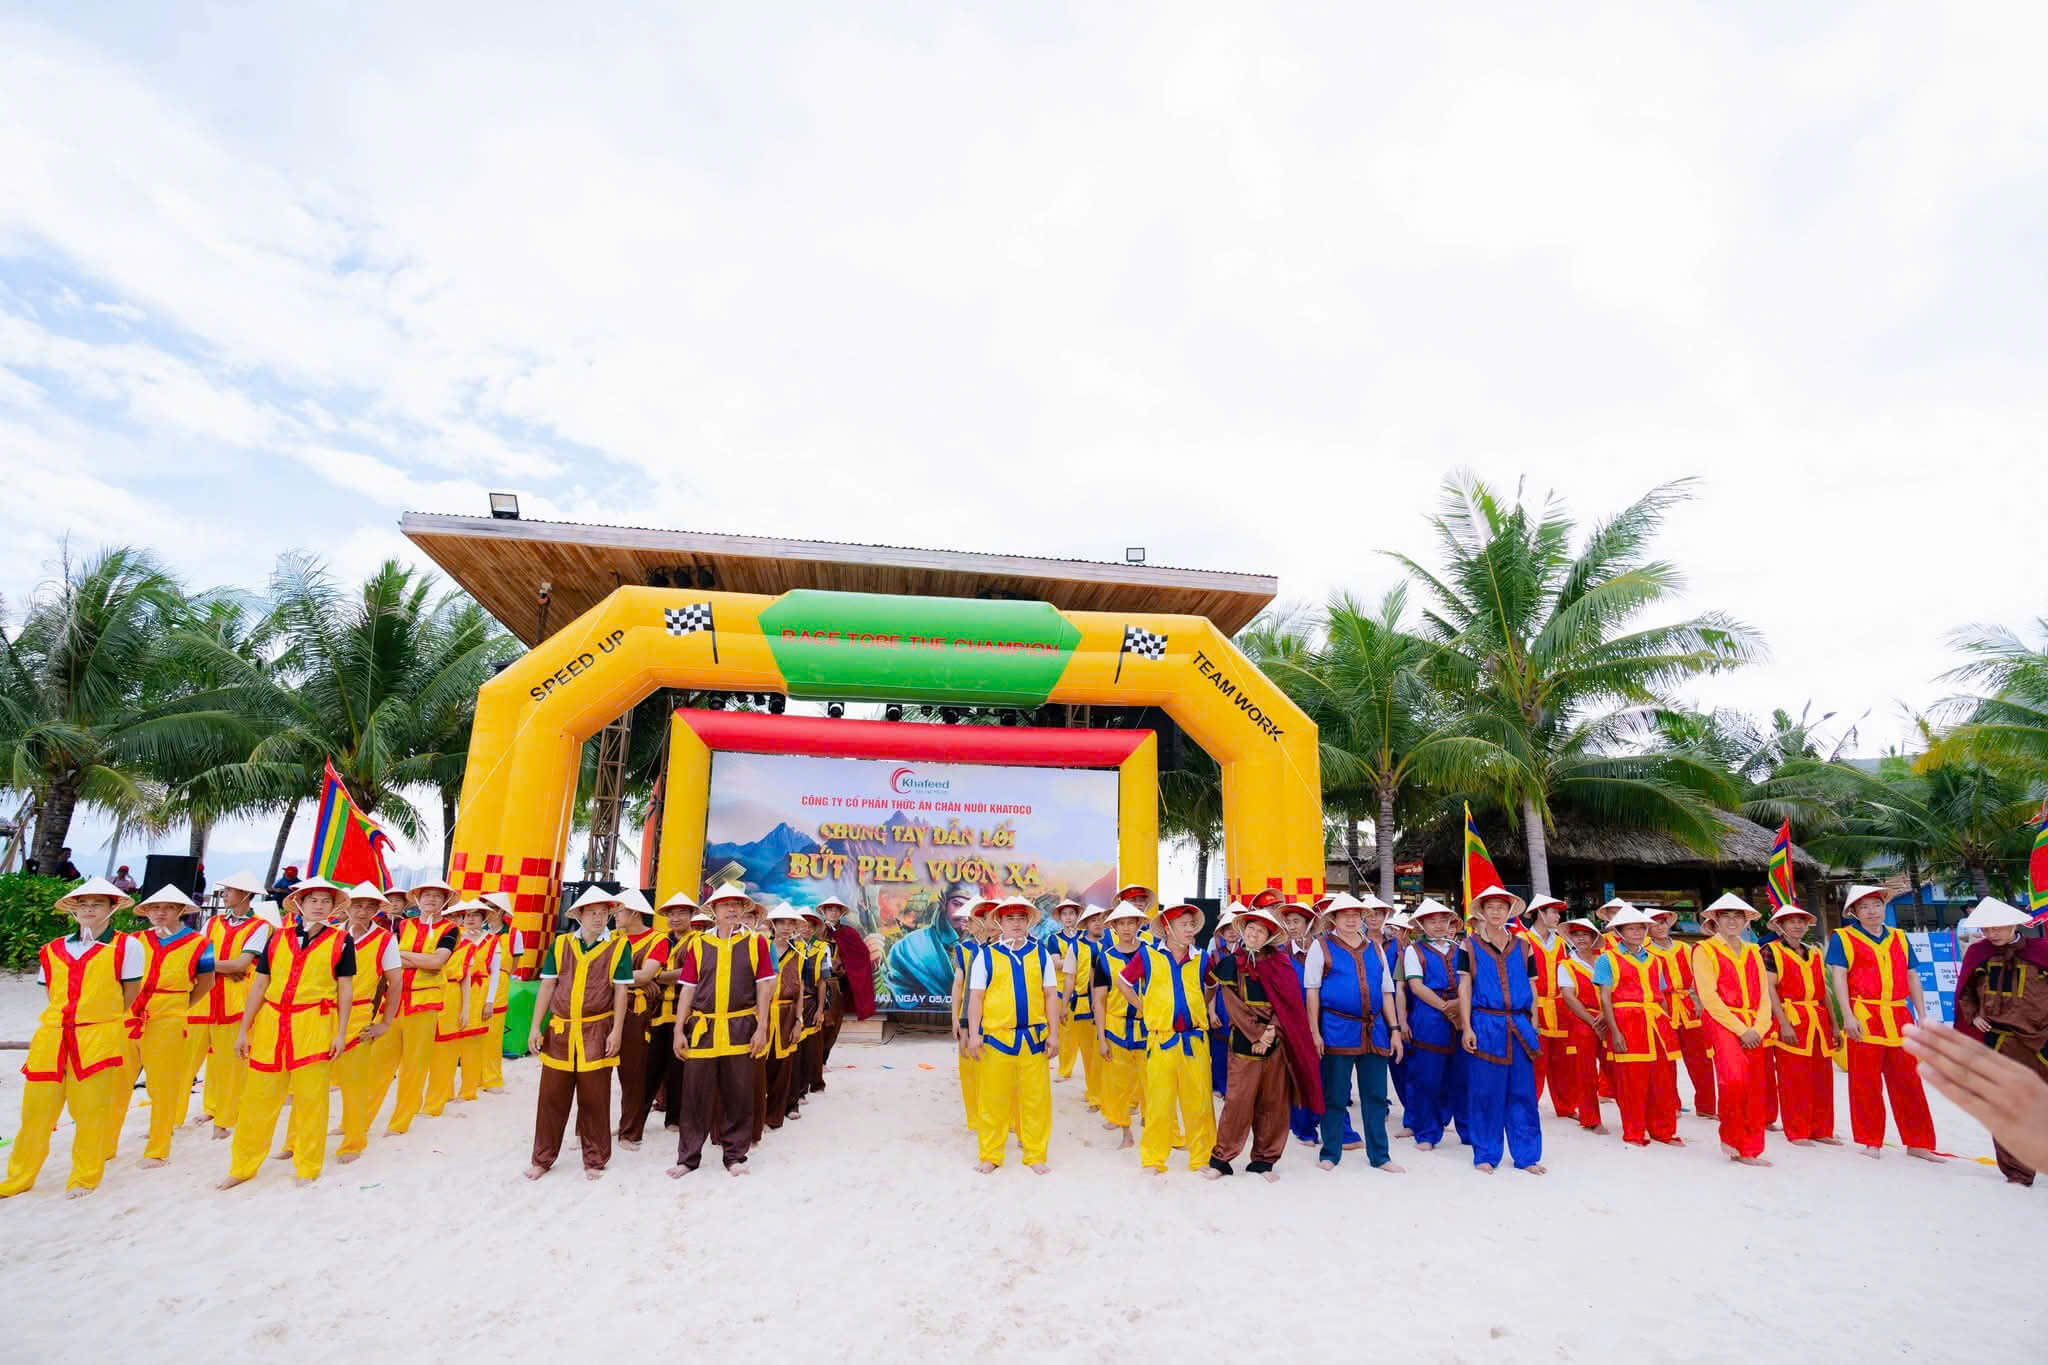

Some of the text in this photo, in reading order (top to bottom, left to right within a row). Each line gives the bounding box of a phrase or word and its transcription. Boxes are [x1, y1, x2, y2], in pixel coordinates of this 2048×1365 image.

[780, 629, 841, 646] RACE
[908, 635, 947, 652] THE
[953, 638, 1060, 658] CHAMPION
[530, 630, 625, 702] SPEED UP
[902, 777, 950, 789] Khafeed
[801, 795, 829, 806] CÔNG
[832, 797, 843, 807] TY
[990, 803, 1032, 815] KHATOCO
[820, 824, 887, 846] CHUNG
[891, 825, 929, 848] TAY
[856, 847, 914, 887] PHÁ
[1004, 863, 1041, 892] XA
[896, 992, 926, 1004] NGÀY
